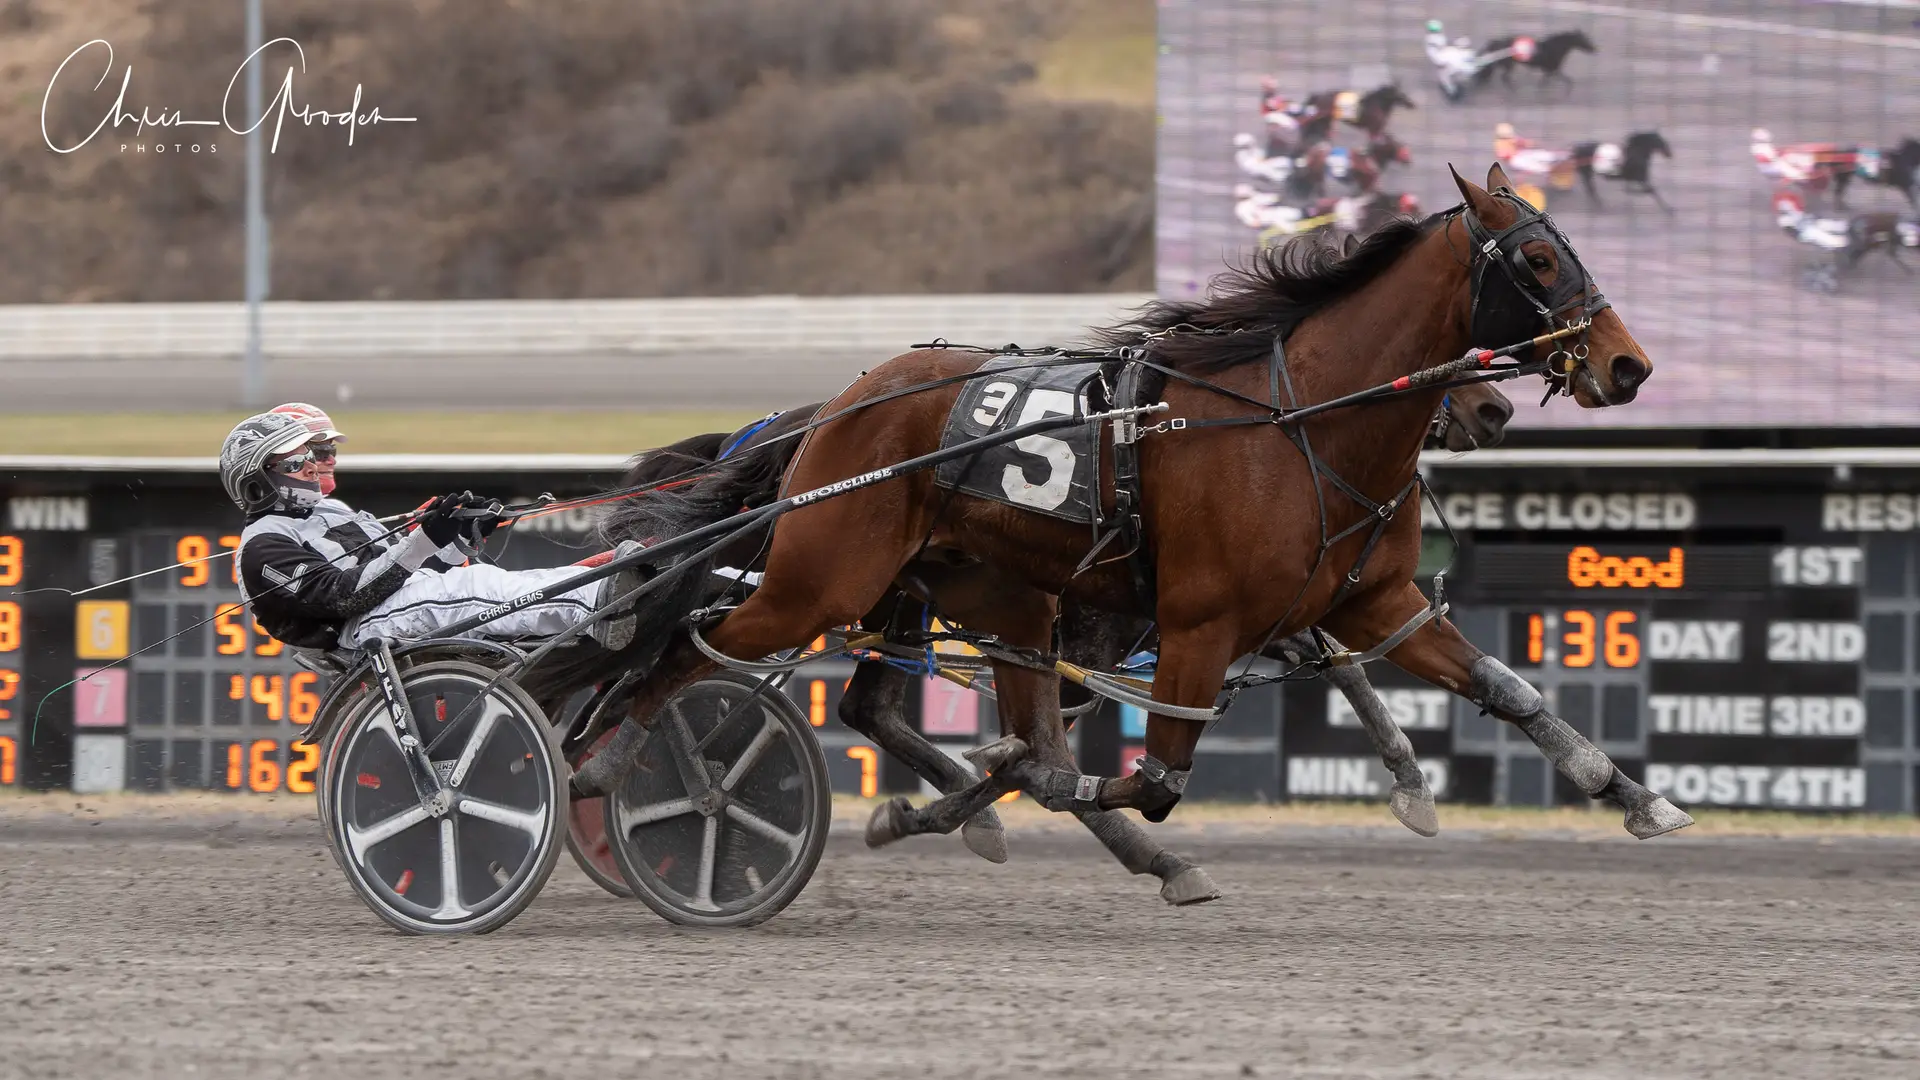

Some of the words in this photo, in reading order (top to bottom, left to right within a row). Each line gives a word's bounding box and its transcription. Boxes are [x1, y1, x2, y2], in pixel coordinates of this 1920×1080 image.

[1001, 388, 1088, 511] 5
[9, 498, 87, 530] WIN
[1421, 494, 1504, 530] ACE
[1515, 494, 1695, 530] CLOSED
[1822, 494, 1920, 531] RES
[1567, 546, 1684, 588] Good
[1772, 547, 1862, 585] 1ST
[478, 602, 511, 621] CHRIS
[514, 590, 544, 608] LEMS
[1527, 609, 1641, 668] 1:36
[1650, 621, 1740, 661] DAY
[1767, 622, 1866, 662] 2ND
[1327, 688, 1450, 728] PST
[1649, 695, 1764, 734] TIME
[1770, 696, 1866, 735] 3RD
[227, 740, 320, 793] 162
[1288, 757, 1380, 795] MIN.
[1646, 765, 1768, 803] POST
[1770, 767, 1866, 806] 4TH
